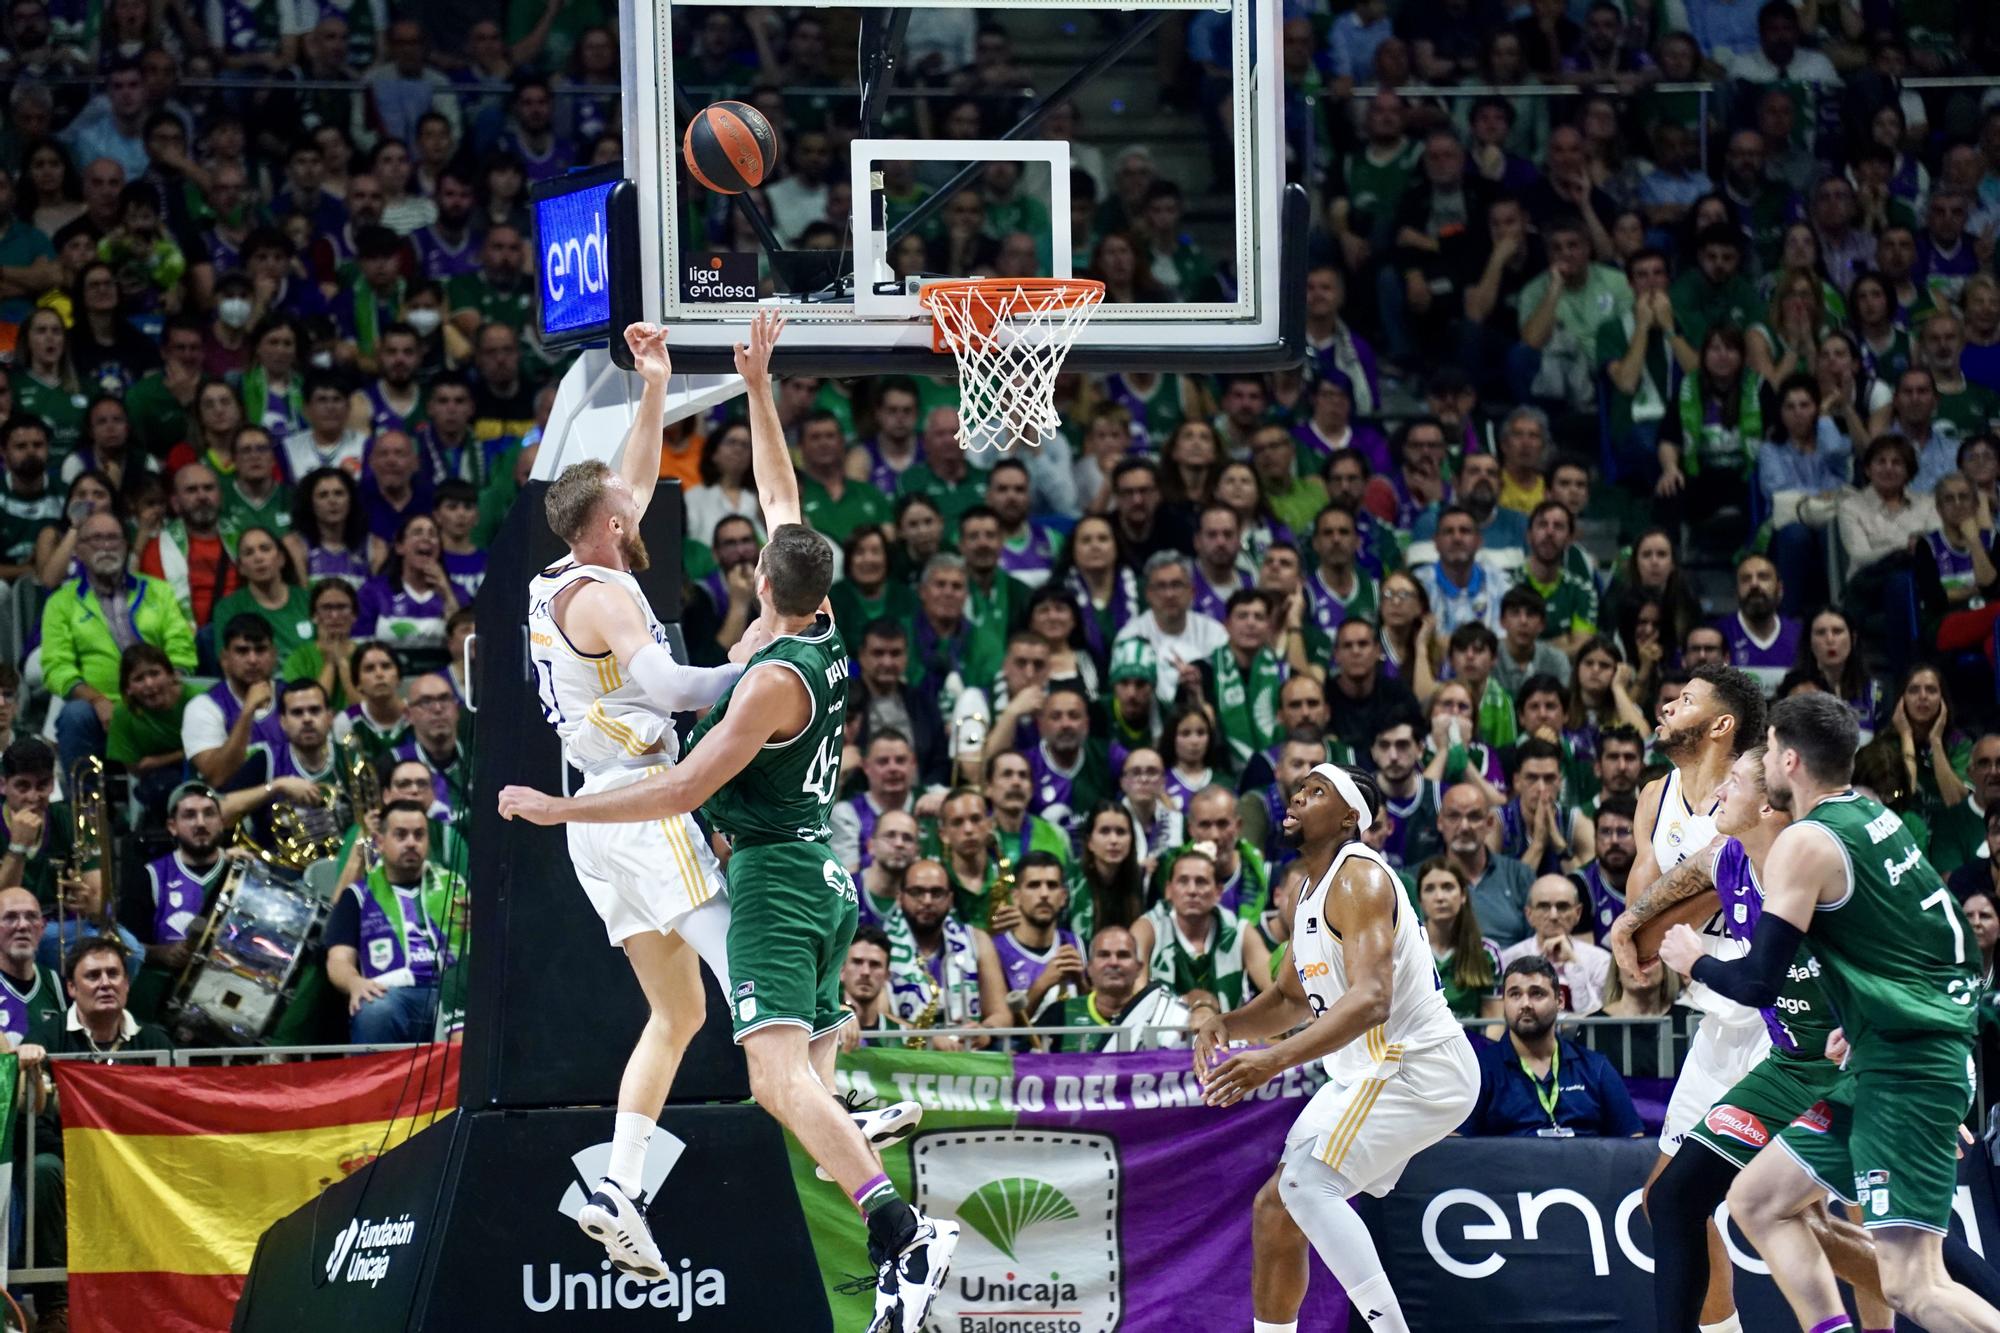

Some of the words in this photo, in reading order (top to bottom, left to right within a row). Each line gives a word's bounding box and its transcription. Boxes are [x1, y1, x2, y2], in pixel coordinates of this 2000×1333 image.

[689, 266, 720, 284] liga
[689, 282, 756, 298] endesa
[1919, 887, 1966, 964] 7
[892, 1072, 1046, 1113] TEMPLO
[1054, 1074, 1126, 1112] DEL
[346, 1248, 391, 1290] Unicaja
[522, 1257, 726, 1323] Unicaja
[960, 1271, 1078, 1310] Unicaja
[960, 1317, 1081, 1333] Baloncesto
